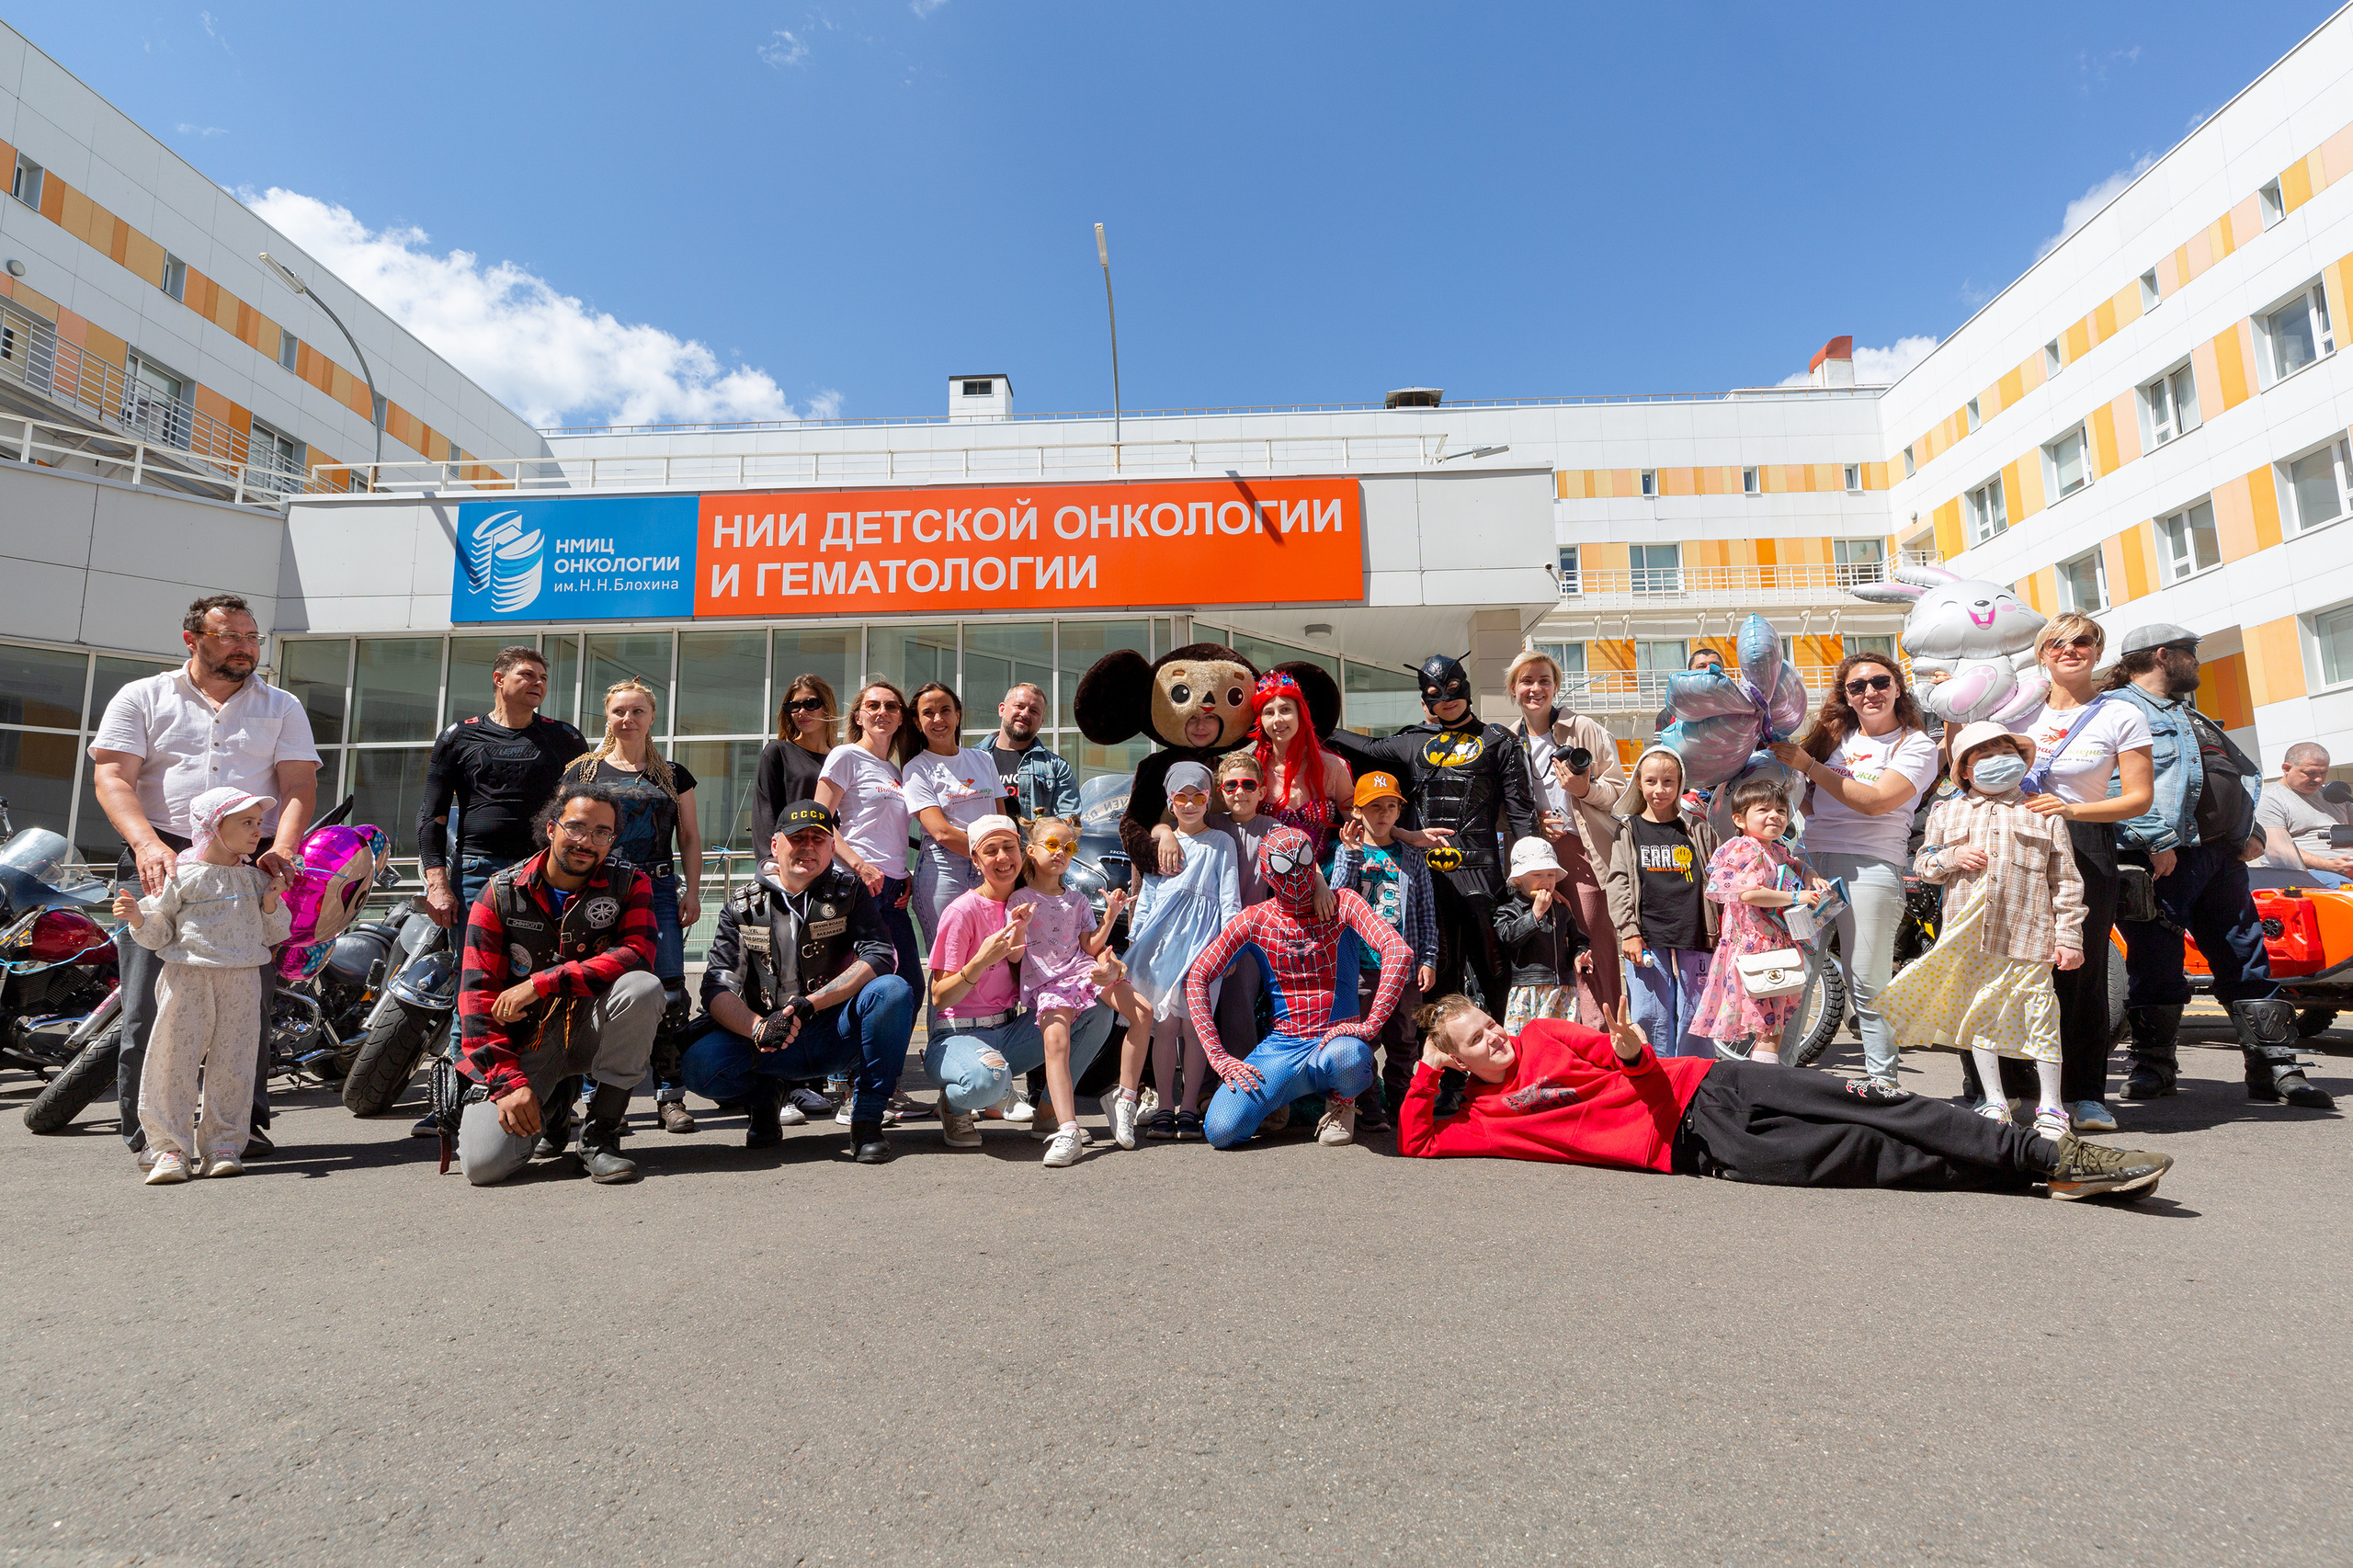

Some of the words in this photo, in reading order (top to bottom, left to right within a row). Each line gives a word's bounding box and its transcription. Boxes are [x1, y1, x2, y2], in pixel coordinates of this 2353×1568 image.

[713, 513, 807, 549] НИИ
[820, 497, 1038, 552] ДЕТСКОЙ
[1053, 498, 1343, 540] ОНКОЛОГИИ
[555, 538, 615, 554] НМИЦ
[553, 556, 680, 574] ОНКОЛОГИИ
[710, 563, 740, 598] И
[756, 555, 1097, 597] ГЕМАТОЛОГИИ
[791, 810, 825, 821] СССР
[816, 927, 843, 937] MEMBER
